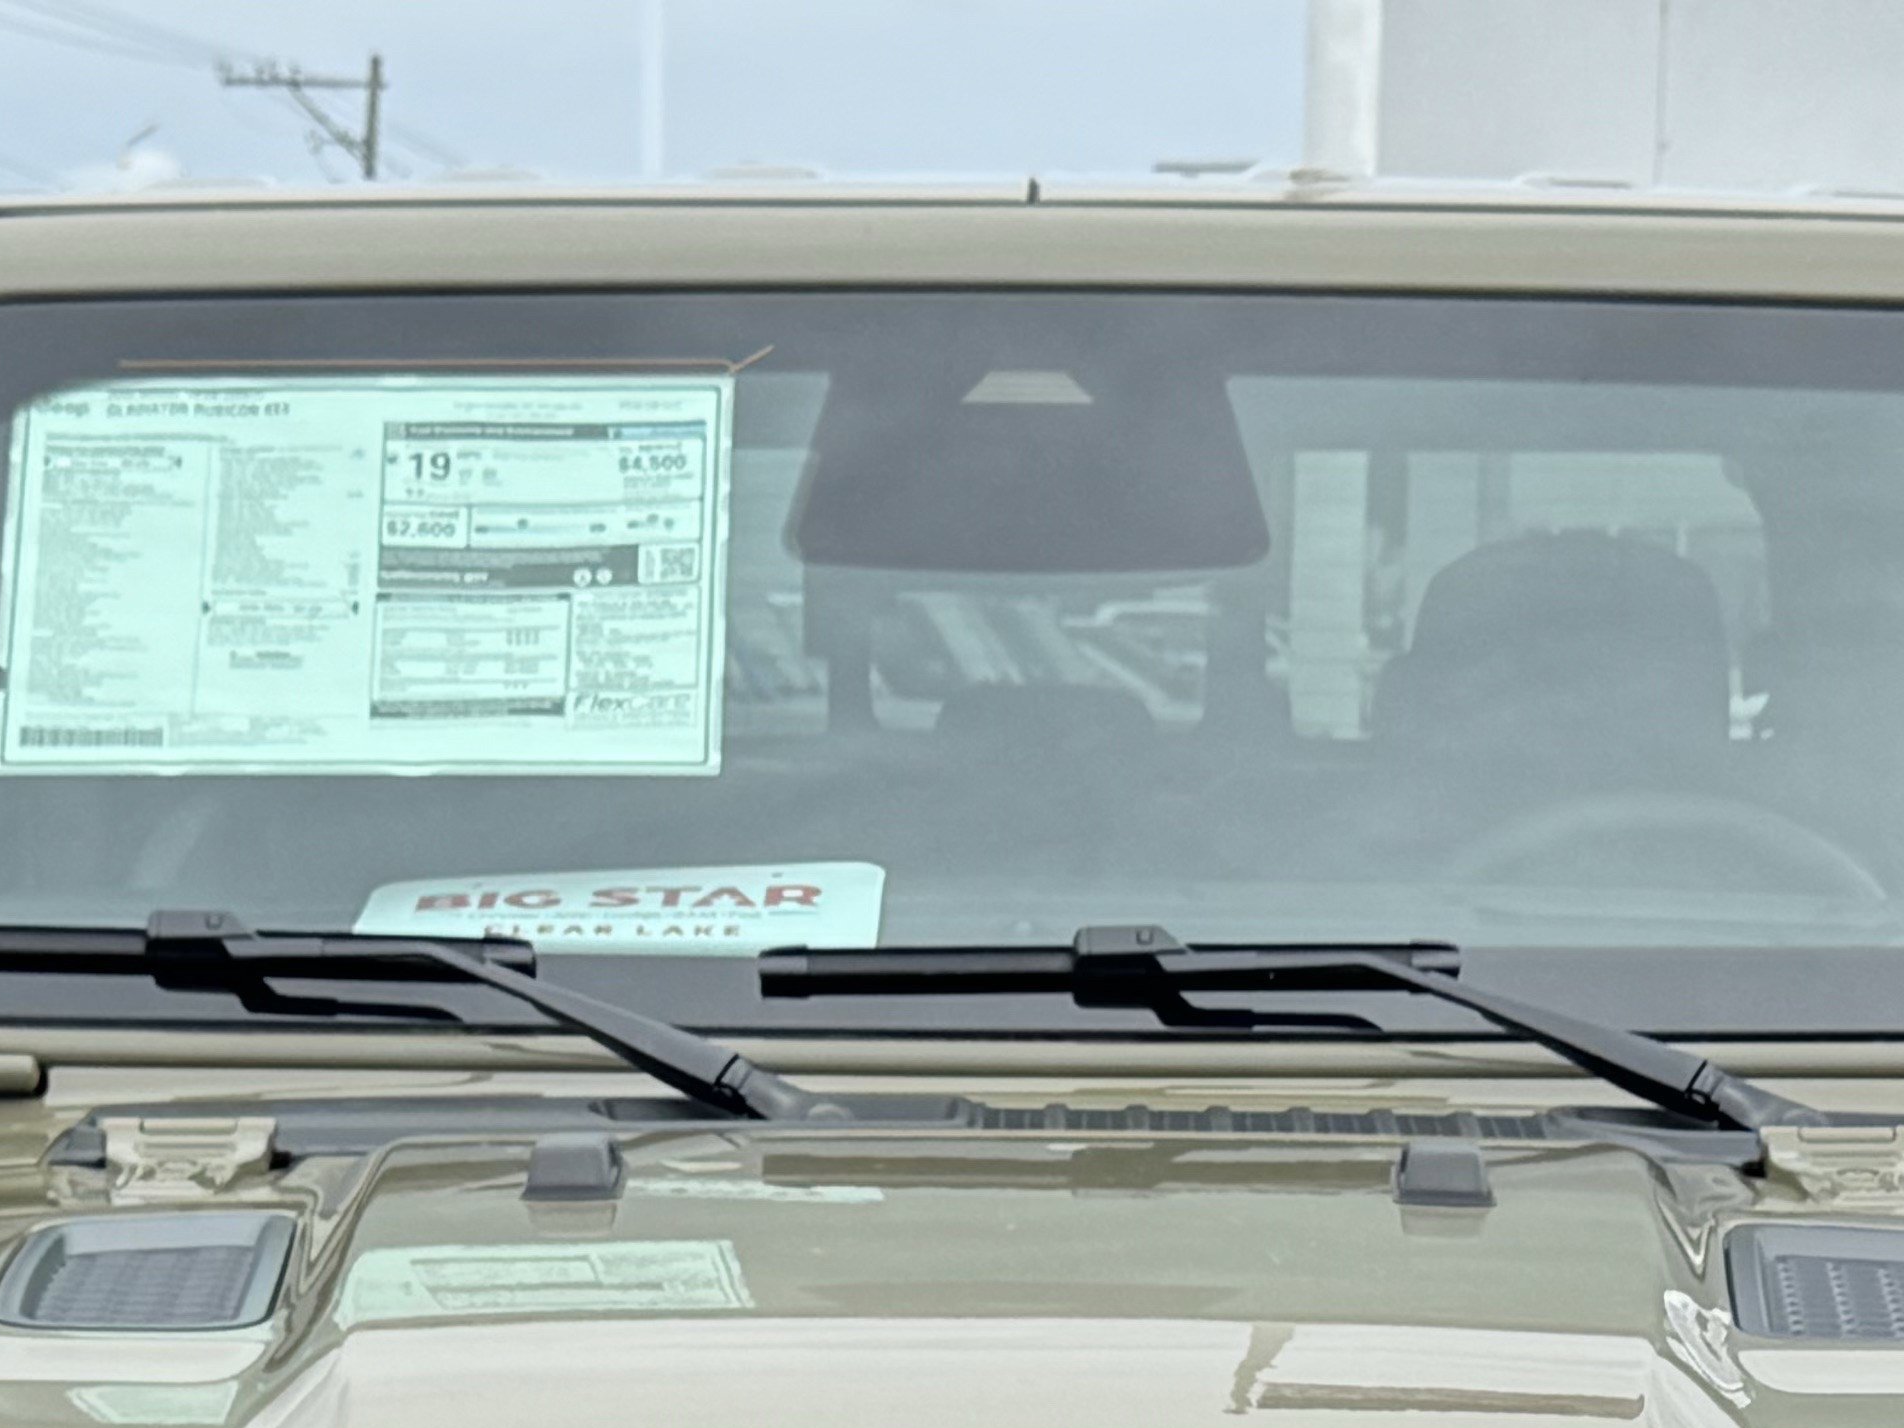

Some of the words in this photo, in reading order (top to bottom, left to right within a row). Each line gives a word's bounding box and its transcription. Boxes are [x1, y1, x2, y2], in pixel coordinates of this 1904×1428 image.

[408, 451, 451, 481] 19
[414, 888, 561, 913] BIG
[588, 885, 823, 910] STAR
[635, 923, 743, 938] LAKE
